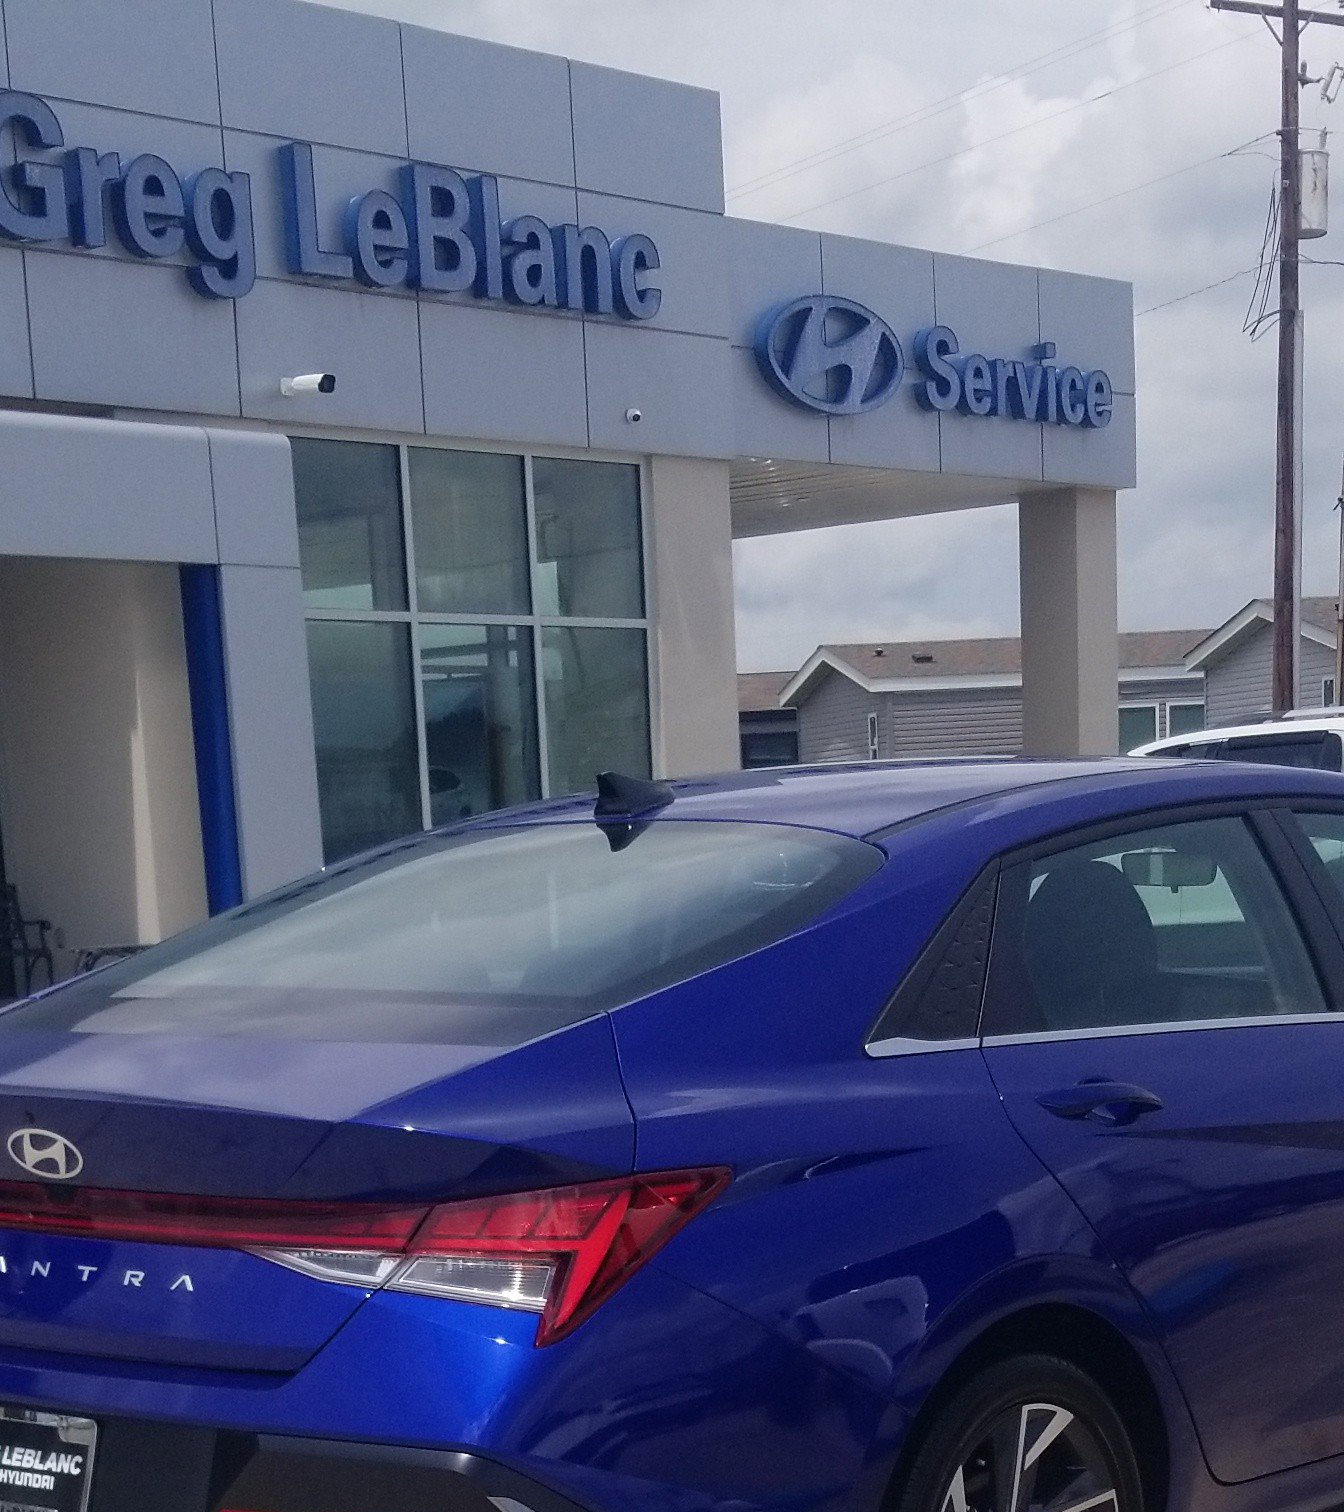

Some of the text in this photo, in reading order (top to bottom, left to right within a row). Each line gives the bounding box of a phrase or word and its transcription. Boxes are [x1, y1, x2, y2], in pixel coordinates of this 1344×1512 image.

[279, 141, 662, 321] LeBlanc
[913, 325, 1114, 428] Service
[1, 1445, 84, 1475] LEBLANC
